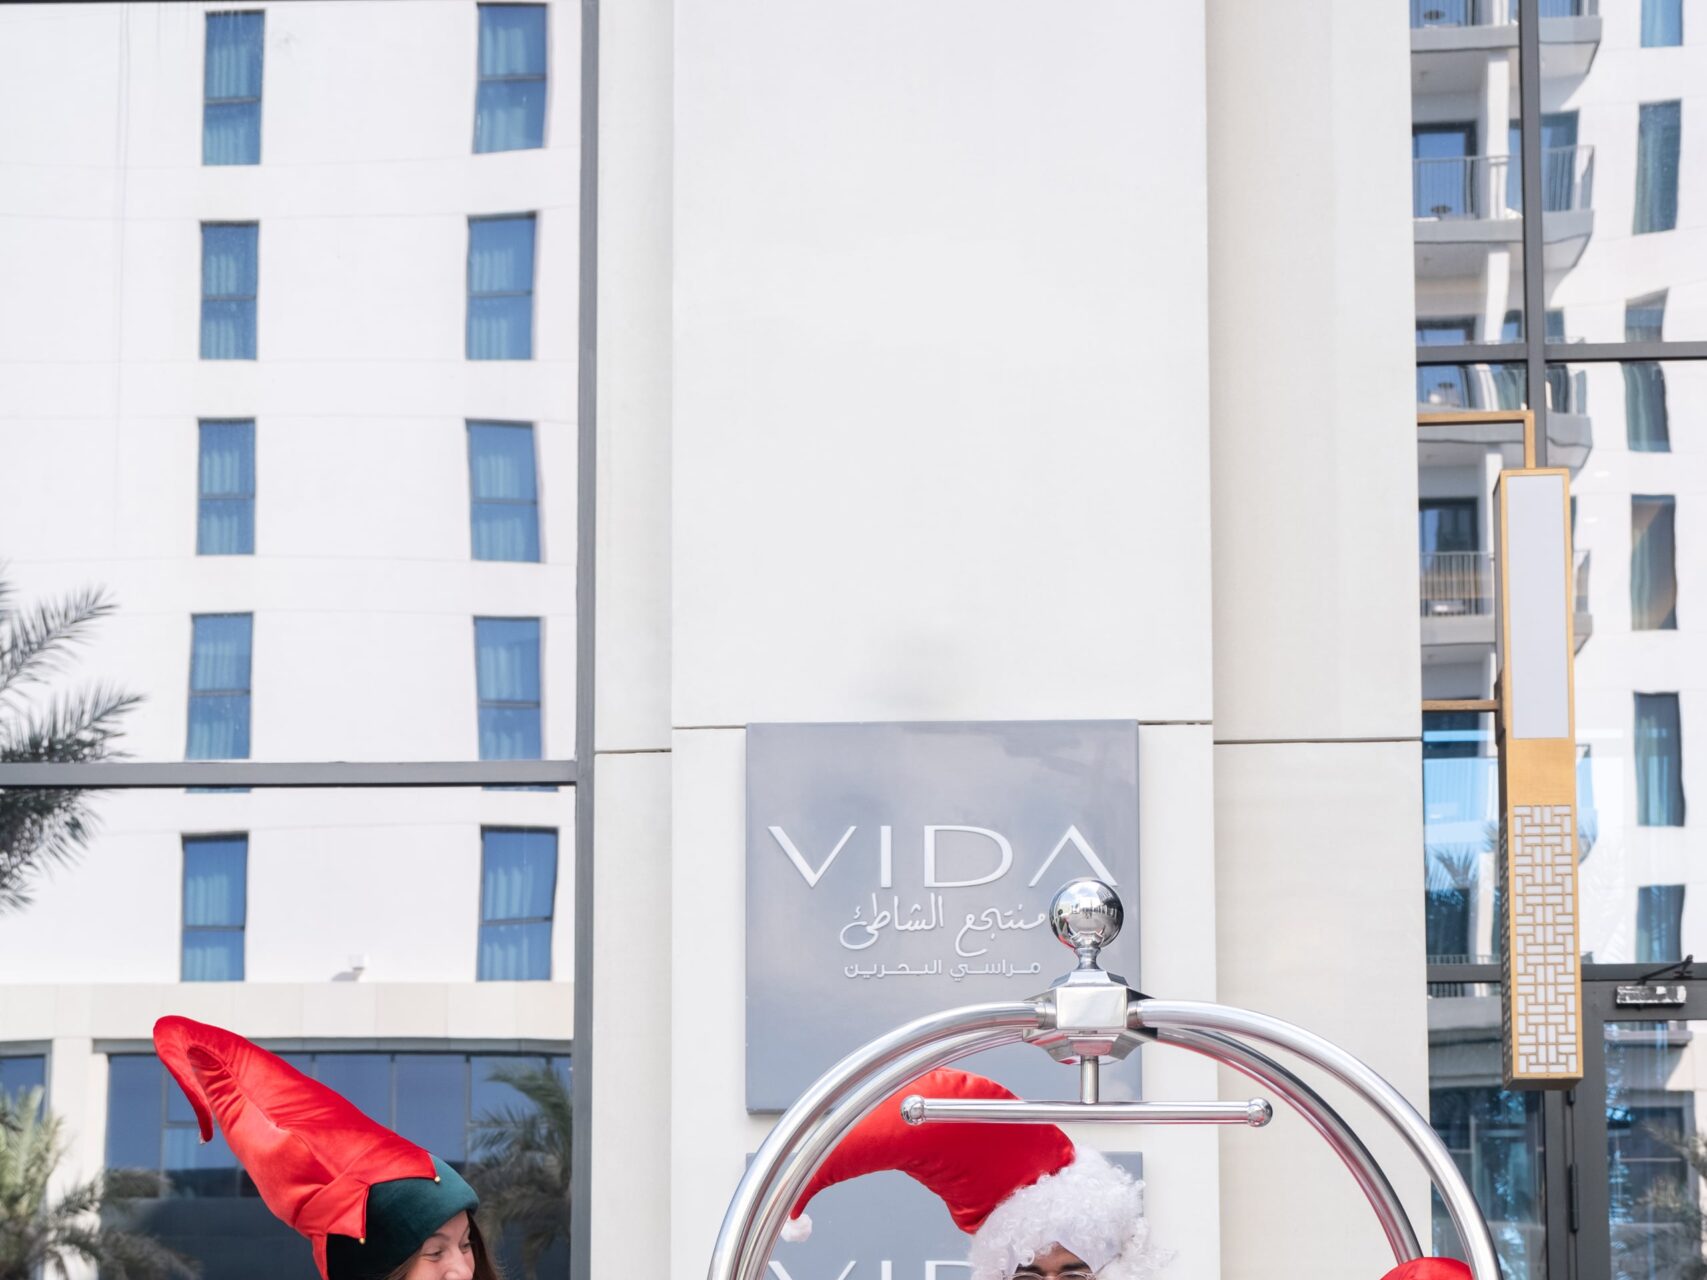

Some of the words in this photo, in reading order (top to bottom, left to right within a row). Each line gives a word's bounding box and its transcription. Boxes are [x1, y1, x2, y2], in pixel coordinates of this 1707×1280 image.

[768, 824, 1119, 888] VIDA
[839, 892, 944, 950] الشاطئ
[955, 904, 1046, 957] منتجع
[844, 959, 942, 978] البحرين
[949, 959, 1041, 983] مراسي
